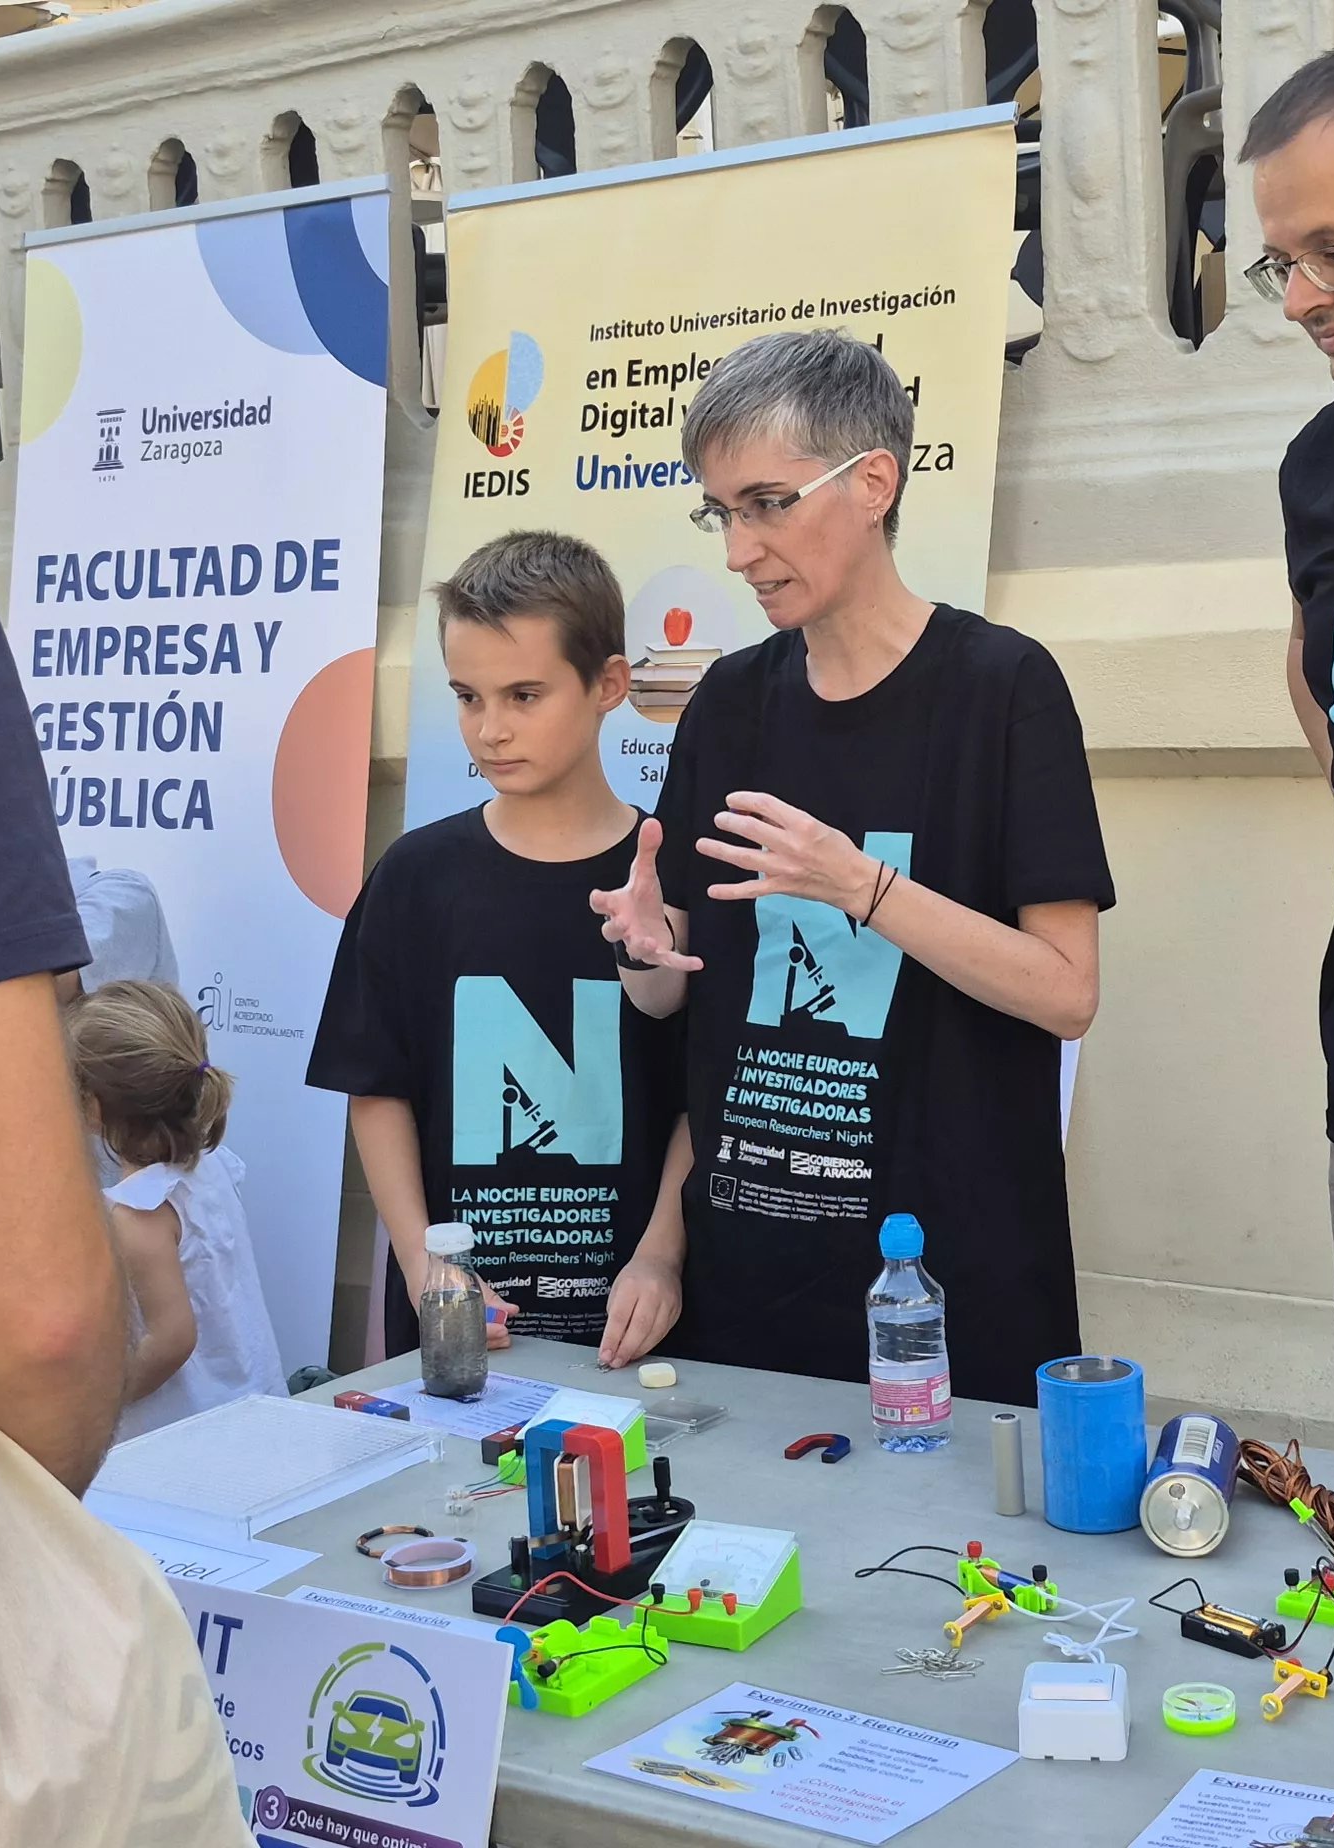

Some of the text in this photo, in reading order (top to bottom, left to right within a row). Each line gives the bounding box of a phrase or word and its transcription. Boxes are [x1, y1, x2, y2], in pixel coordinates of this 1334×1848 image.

[589, 285, 956, 342] Instituto Universitario de Investigación
[586, 368, 617, 390] en
[141, 396, 272, 435] Universidad
[581, 397, 675, 438] Digital
[140, 439, 223, 464] Zaragoza
[463, 468, 531, 499] IEDIS
[36, 538, 341, 604] FACULTAD DE
[32, 620, 283, 678] EMPRESA Y
[31, 690, 224, 753] GESTIÓN
[50, 765, 215, 831] ÚBLICA
[234, 997, 260, 1008] CENTRO
[233, 1011, 274, 1023] ACREDITADO
[233, 1024, 306, 1039] INSTITUCIONALMENTE
[736, 1045, 880, 1080] LA NOCHE EUROPEA
[741, 1066, 868, 1101] INVESTIGADORES
[725, 1086, 872, 1124] E INVESTIGADORAS
[723, 1109, 874, 1147] European Researchers' Night
[808, 1165, 821, 1177] DE
[809, 1154, 865, 1169] GOBIERNO
[451, 1187, 620, 1203] LA NOCHE EUROPEA
[462, 1207, 611, 1225] INVESTIGADORES
[471, 1229, 614, 1246] NVESTIGADORAS
[508, 1252, 582, 1265] Researchers'
[584, 1251, 615, 1266] Night
[487, 1276, 609, 1290] iversidad GOBIERNO
[556, 1289, 571, 1298] DE
[164, 1557, 223, 1580] del
[303, 1591, 378, 1614] Experimento
[393, 1609, 452, 1628] Inducción
[747, 1689, 960, 1749] Experimento 3: Electroimán
[890, 1746, 939, 1763] corriente
[265, 1795, 280, 1821] 3
[289, 1808, 324, 1831] ¿Qué
[326, 1816, 351, 1841] hay
[352, 1827, 379, 1848] que
